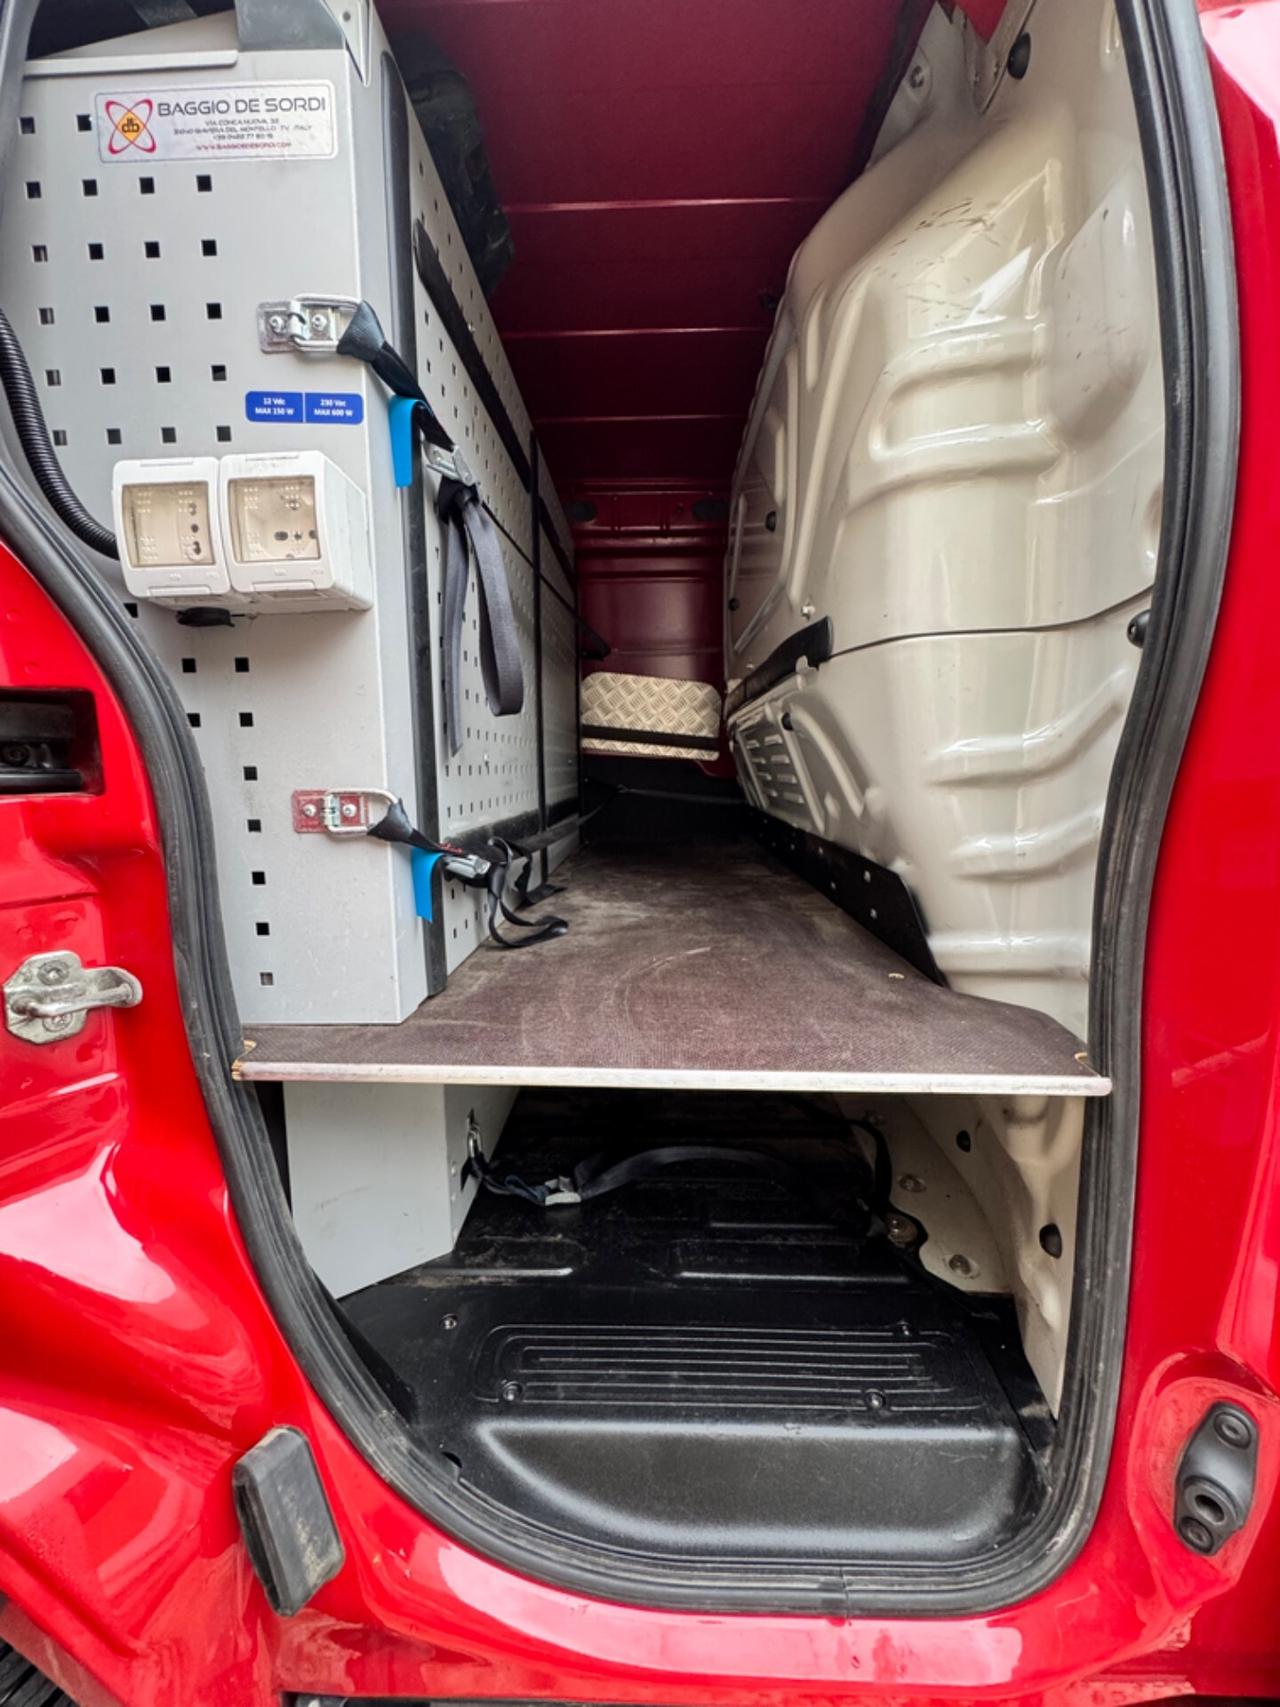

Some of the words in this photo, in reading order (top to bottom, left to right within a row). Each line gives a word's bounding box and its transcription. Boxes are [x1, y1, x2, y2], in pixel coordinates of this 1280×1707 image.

[157, 100, 230, 117] BAGGIO
[234, 98, 260, 113] DE
[264, 96, 326, 112] SORDI
[255, 407, 272, 415] MAX
[285, 408, 295, 416] W
[313, 408, 331, 416] MAX
[345, 409, 354, 417] W
